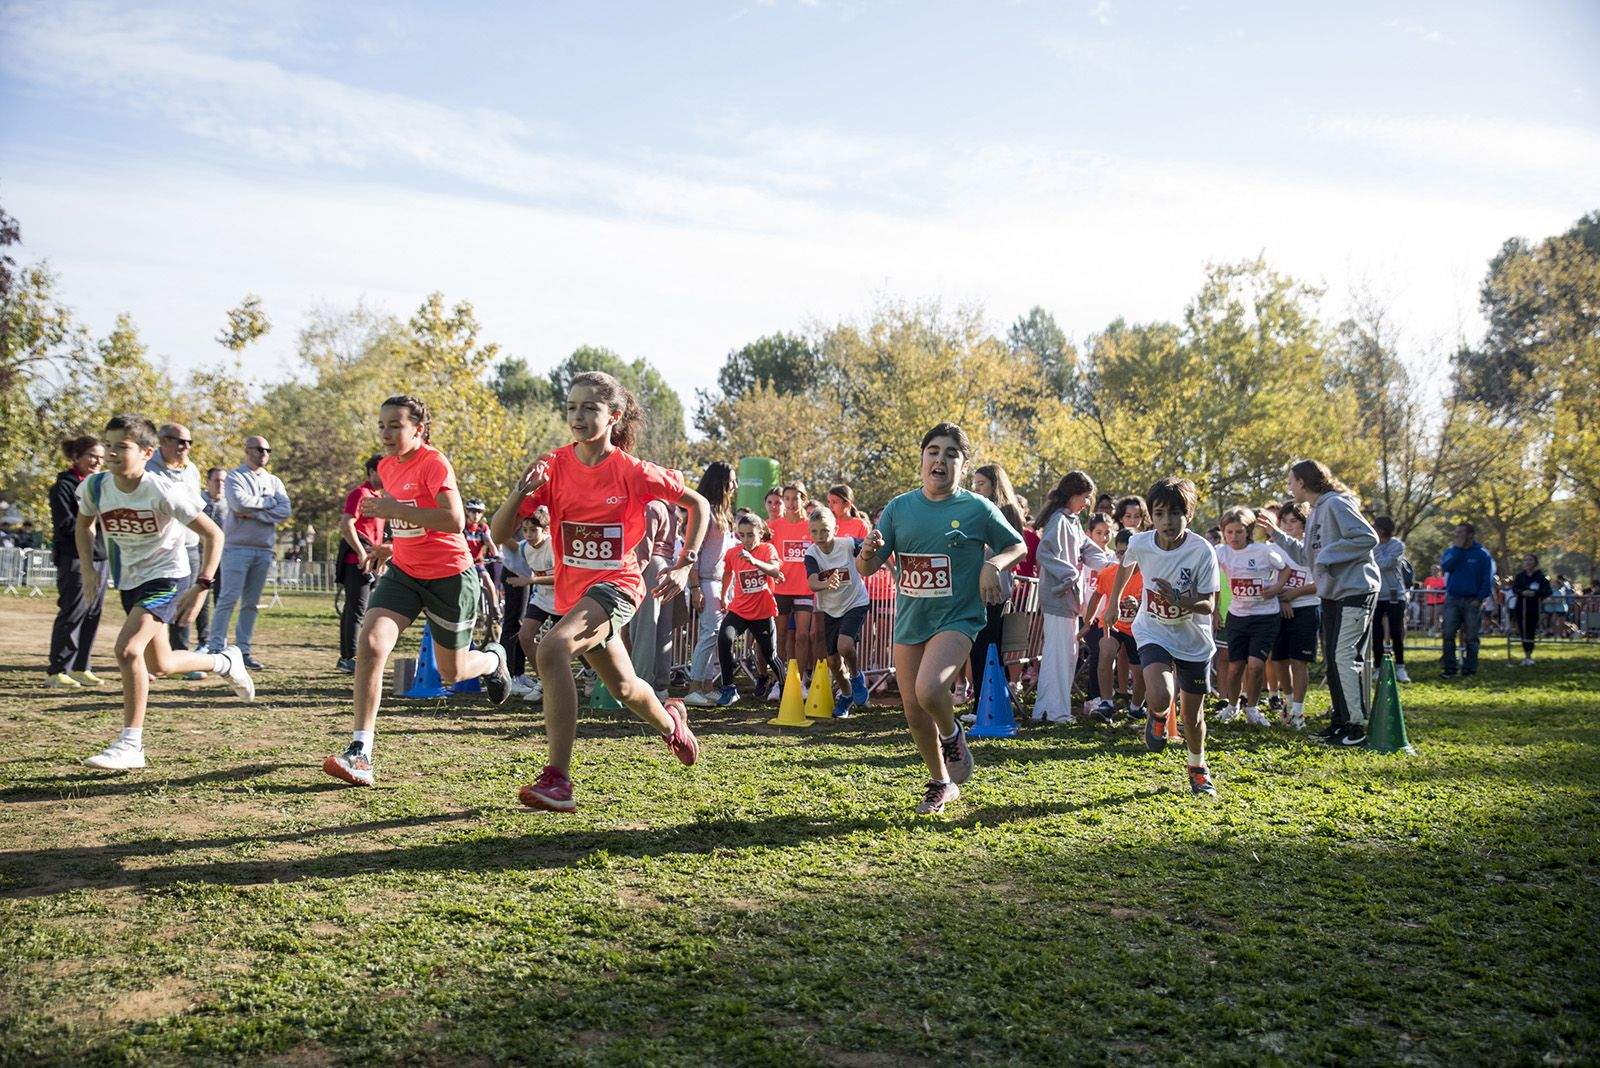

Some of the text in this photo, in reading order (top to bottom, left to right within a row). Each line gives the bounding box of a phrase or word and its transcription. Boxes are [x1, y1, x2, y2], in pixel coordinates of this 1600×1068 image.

[106, 519, 156, 534] 3536
[572, 540, 613, 559] 988
[745, 576, 765, 588] 996
[903, 570, 948, 588] 2028
[1233, 586, 1261, 596] 4201
